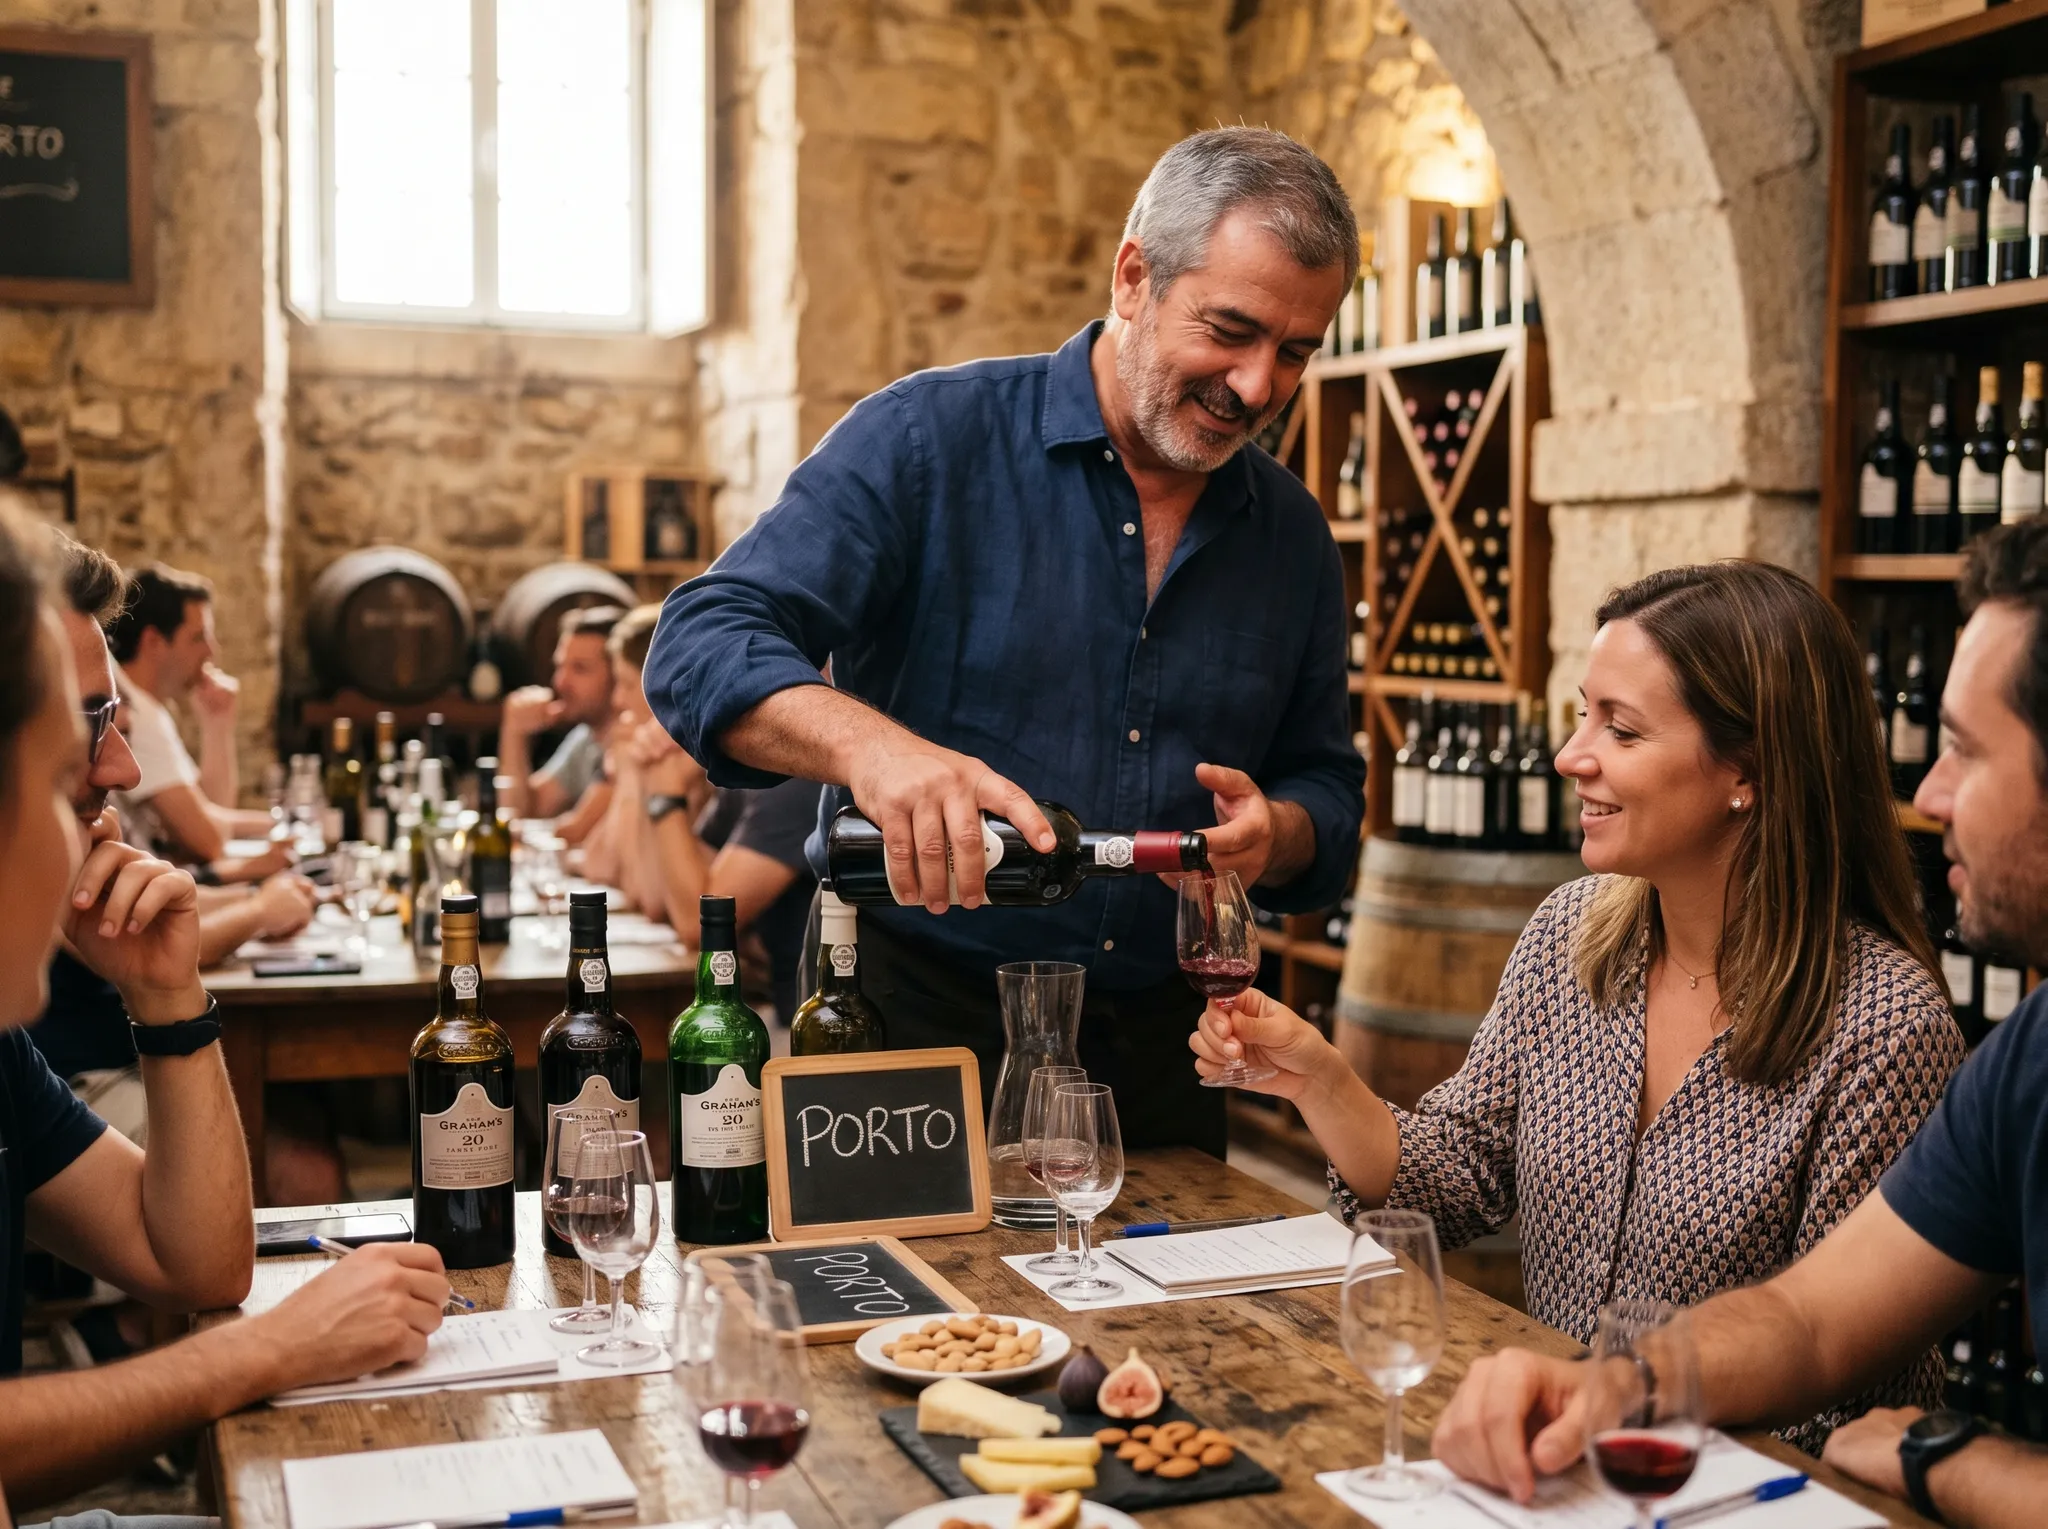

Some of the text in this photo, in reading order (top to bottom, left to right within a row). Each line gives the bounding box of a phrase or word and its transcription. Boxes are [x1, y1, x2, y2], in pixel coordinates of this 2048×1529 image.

[439, 1117, 503, 1130] GRAHAM'S
[462, 1134, 484, 1146] 20
[797, 1104, 956, 1167] PORTO
[794, 1252, 910, 1315] PORTO
